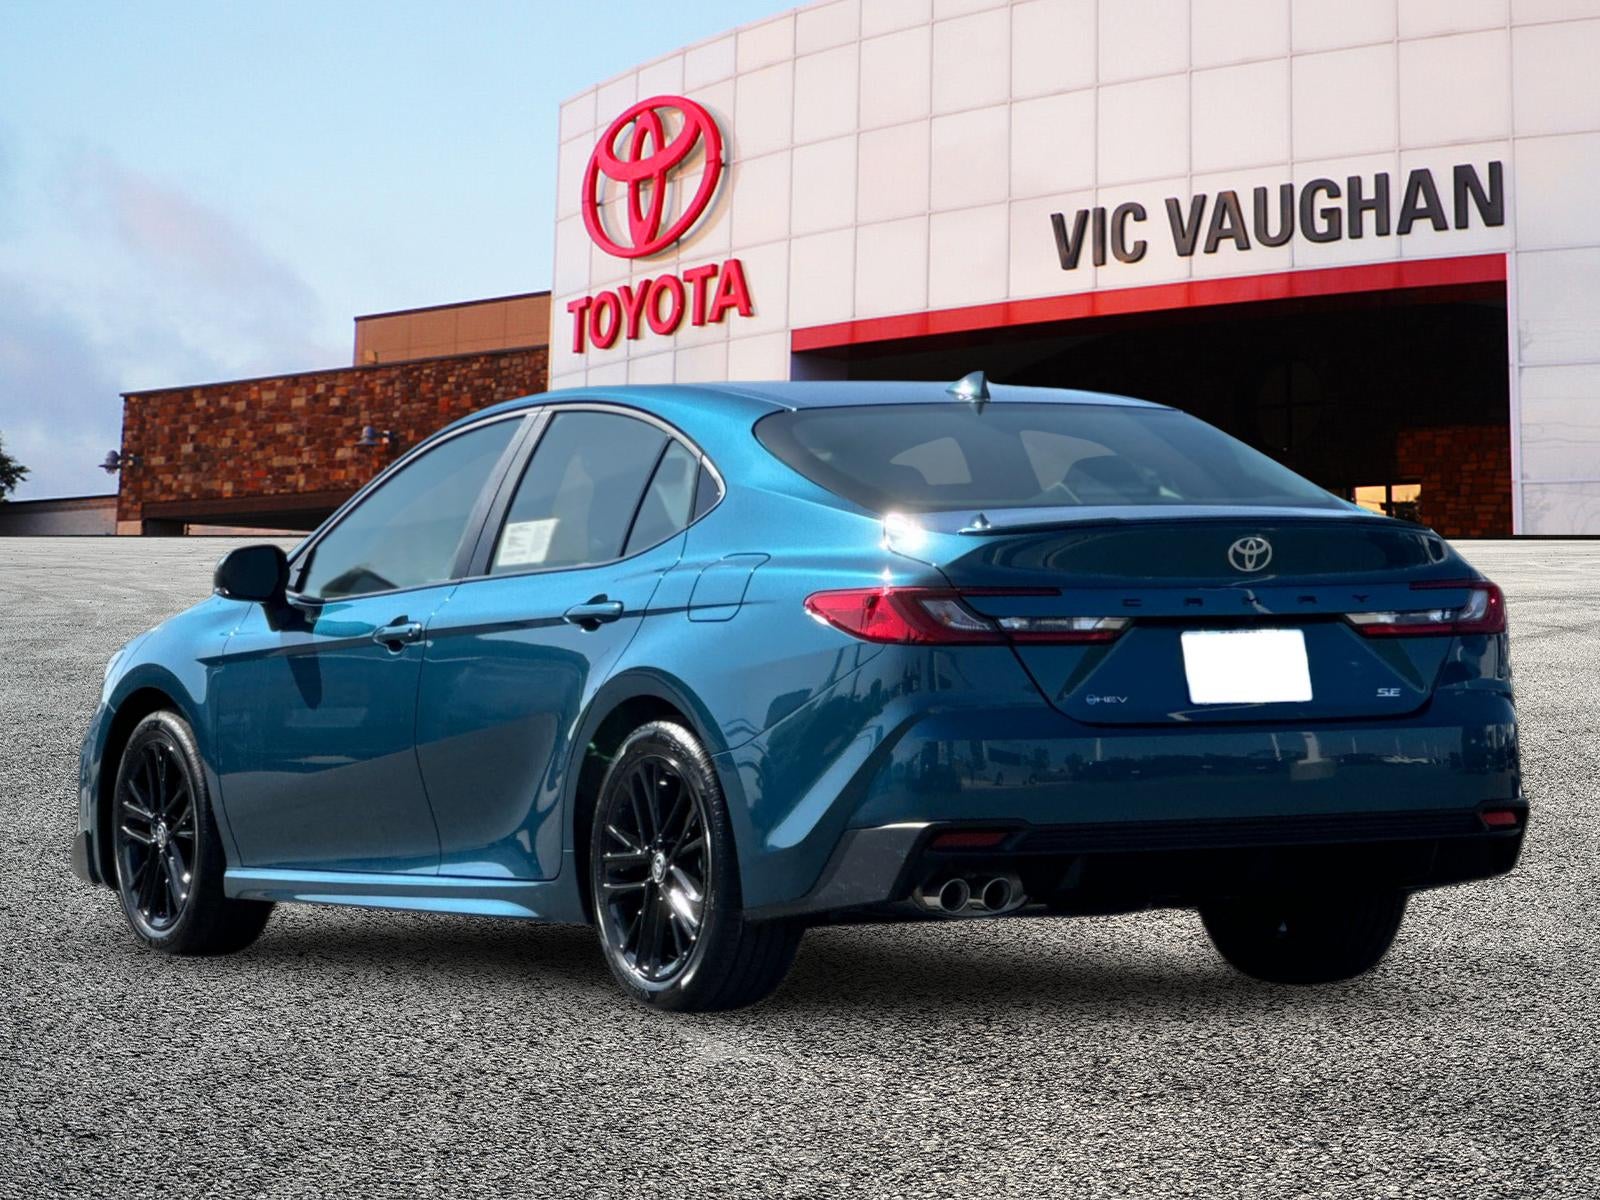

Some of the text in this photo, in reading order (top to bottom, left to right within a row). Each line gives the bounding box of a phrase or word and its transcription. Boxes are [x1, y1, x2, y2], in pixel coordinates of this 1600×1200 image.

[1050, 160, 1505, 270] VIC VAUGHAN
[567, 258, 754, 354] TOYOTA
[1376, 687, 1401, 698] SE
